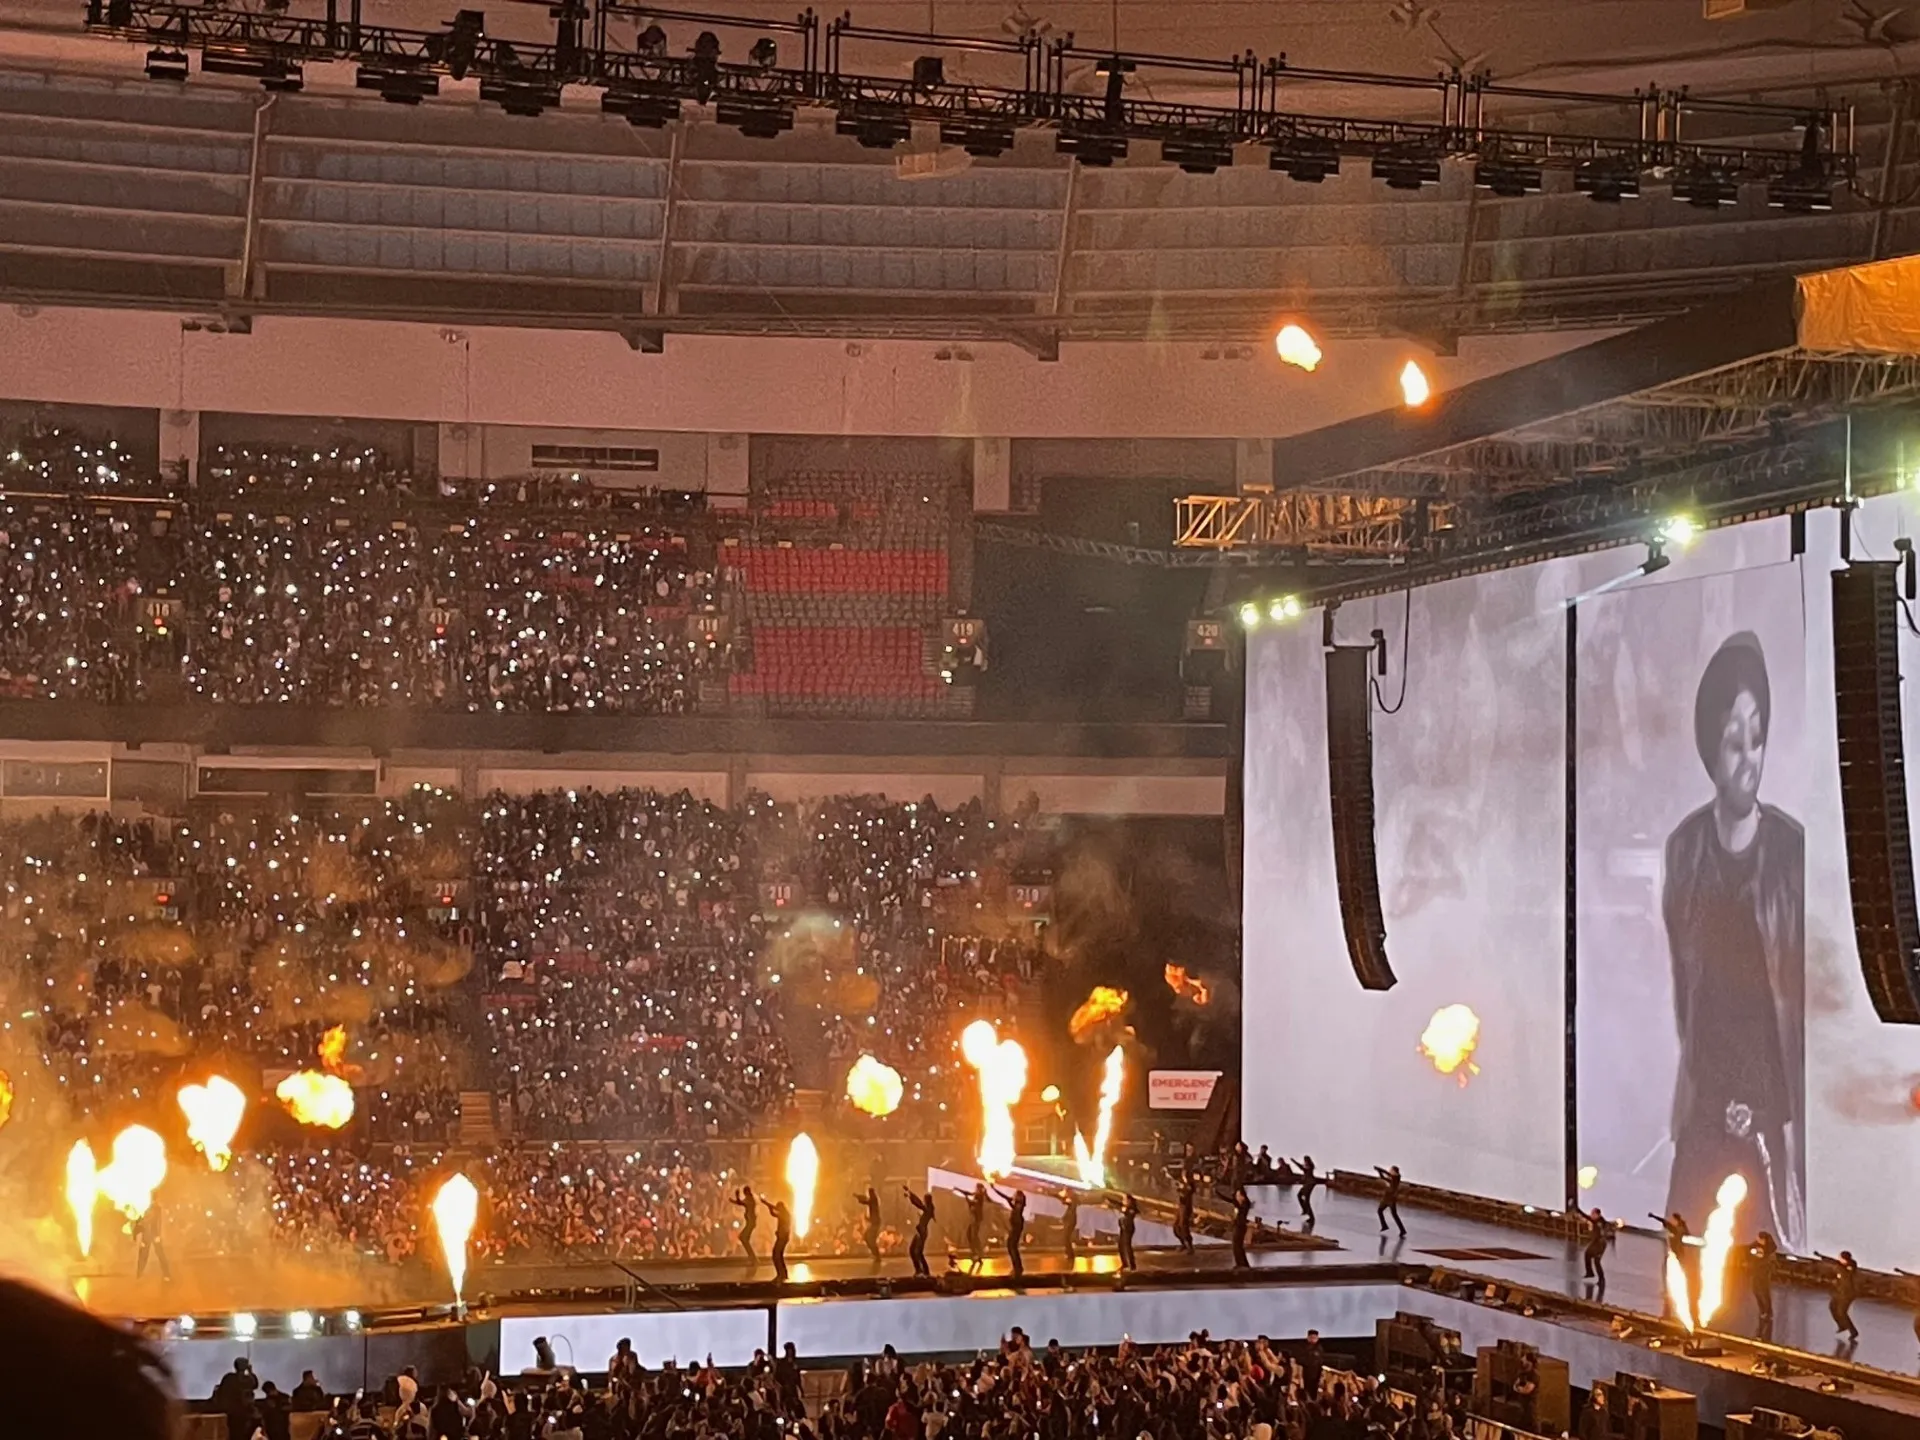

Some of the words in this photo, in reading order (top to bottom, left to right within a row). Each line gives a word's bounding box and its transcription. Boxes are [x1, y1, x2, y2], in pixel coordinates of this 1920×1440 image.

[429, 611, 450, 625] 417
[952, 622, 974, 637] 419
[1197, 624, 1218, 637] 420
[1151, 1078, 1214, 1088] EMERGENC
[1173, 1092, 1198, 1101] EXIT
